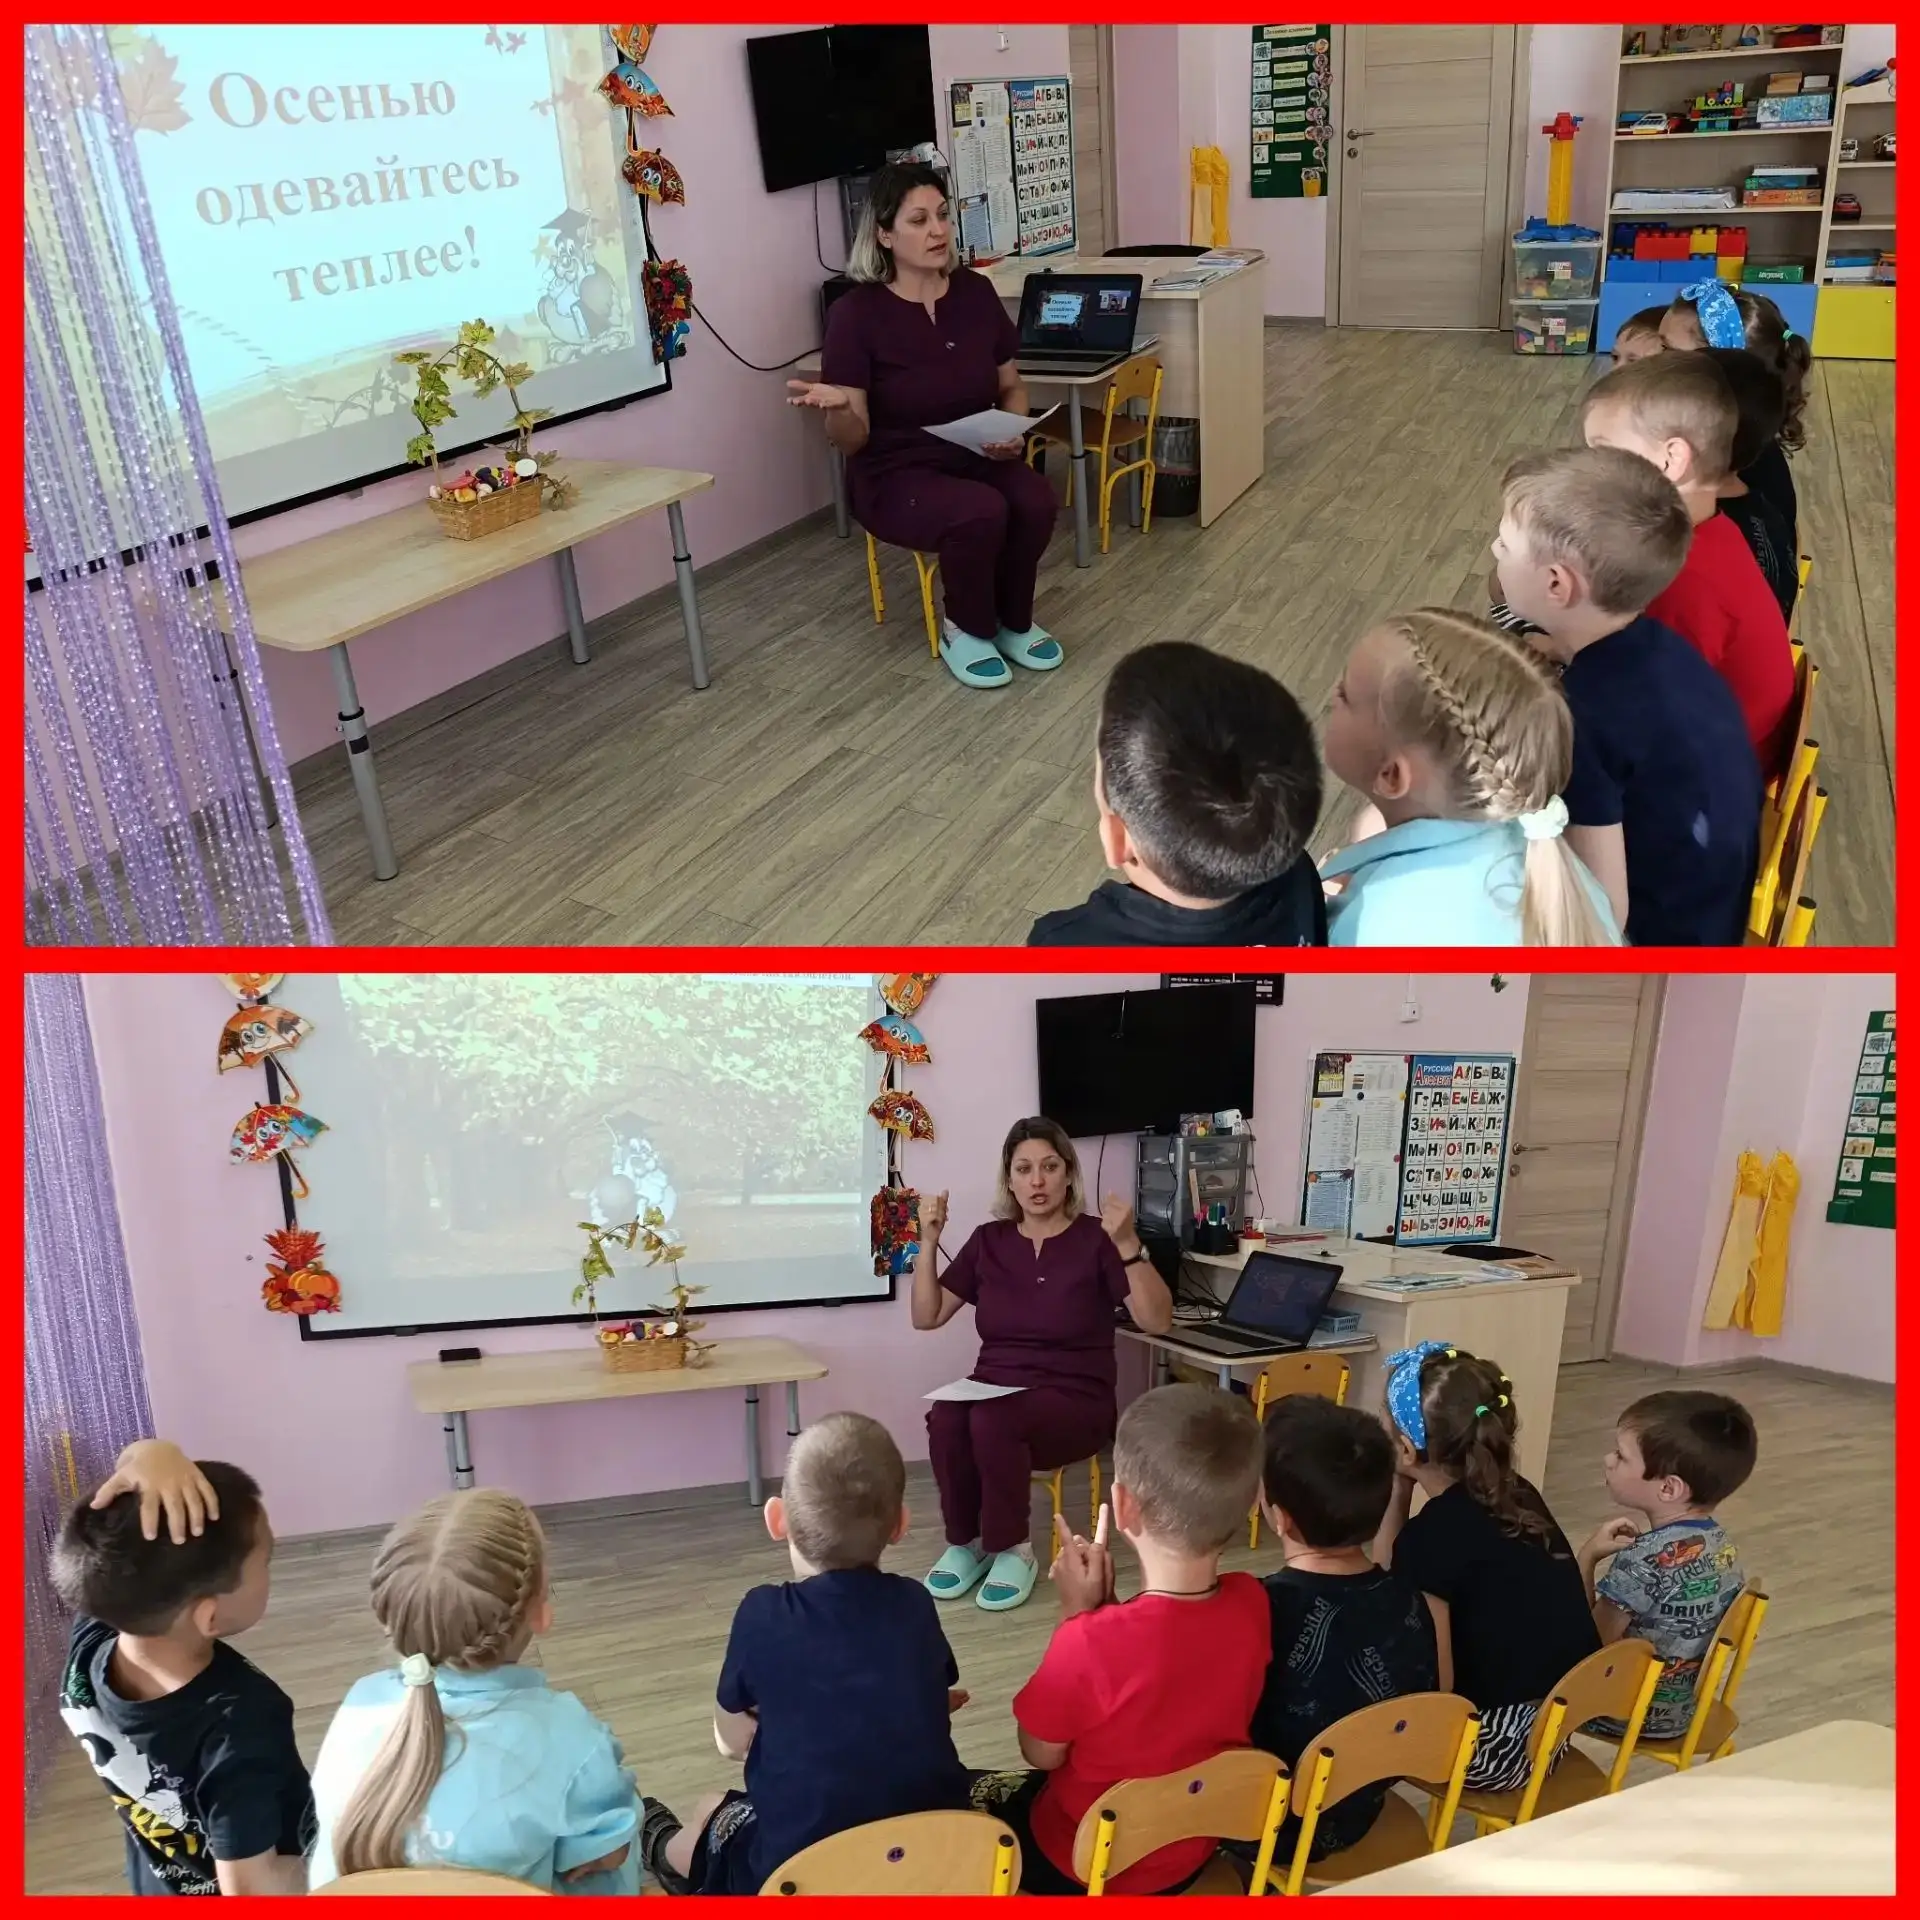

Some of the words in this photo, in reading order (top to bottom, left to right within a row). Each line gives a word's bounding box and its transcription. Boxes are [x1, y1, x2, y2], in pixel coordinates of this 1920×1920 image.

[208, 71, 456, 128] Осенью
[1035, 90, 1042, 101] А
[1046, 89, 1052, 101] Б
[1056, 88, 1063, 100] В
[1015, 115, 1020, 129] Г
[1025, 114, 1032, 127] Д
[1037, 113, 1042, 125] Е
[1015, 139, 1021, 152] З
[1026, 138, 1033, 151] И
[1048, 135, 1054, 148] К
[1059, 134, 1065, 147] Л
[1017, 163, 1024, 177] М
[1028, 162, 1035, 175] Н
[1039, 161, 1044, 173] О
[1050, 159, 1056, 171] П
[1060, 157, 1066, 170] Р
[196, 154, 520, 229] одевайтесь
[1019, 188, 1025, 200] С
[1030, 186, 1035, 199] Т
[1040, 184, 1046, 196] У
[1050, 182, 1057, 193] Ф
[1061, 179, 1067, 189] Х
[1020, 211, 1027, 225] Ц
[1031, 209, 1037, 221] Ч
[1041, 206, 1049, 219] Ш
[1032, 231, 1038, 245] Ь
[1042, 229, 1049, 242] Э
[1063, 224, 1069, 235] Я
[273, 225, 482, 303] теплее!
[1454, 1065, 1463, 1080] А
[1473, 1066, 1483, 1079] Б
[1491, 1066, 1500, 1080] В
[1414, 1091, 1423, 1105] Г
[1431, 1092, 1443, 1107] Д
[1451, 1092, 1461, 1105] Е
[1470, 1089, 1479, 1105] Ё
[1488, 1092, 1501, 1105] Ж
[1410, 1118, 1419, 1130] З
[1430, 1118, 1441, 1130] И
[1449, 1115, 1460, 1130] Й
[1467, 1117, 1477, 1130] К
[1486, 1117, 1496, 1130] Л
[1408, 1143, 1420, 1157] М
[1427, 1143, 1438, 1156] Н
[1447, 1143, 1457, 1156] О
[1465, 1143, 1476, 1155] П
[1483, 1142, 1492, 1155] Р
[1406, 1169, 1415, 1182] С
[1425, 1168, 1435, 1182] Т
[1444, 1168, 1454, 1181] У
[1462, 1167, 1473, 1180] Ф
[1481, 1166, 1491, 1179] Х
[1404, 1195, 1414, 1209] Ц
[1422, 1193, 1431, 1206] Ч
[1441, 1193, 1455, 1205] Ш
[1459, 1192, 1473, 1207] Щ
[1479, 1190, 1488, 1203] Ъ
[1401, 1219, 1413, 1233] Ы
[1420, 1218, 1429, 1231] Ь
[1439, 1218, 1448, 1230] Э
[1456, 1217, 1469, 1229] Ю
[1474, 1215, 1485, 1228] Я
[1661, 1552, 1716, 1590] EXTREME
[1660, 1601, 1714, 1617] DRIVE
